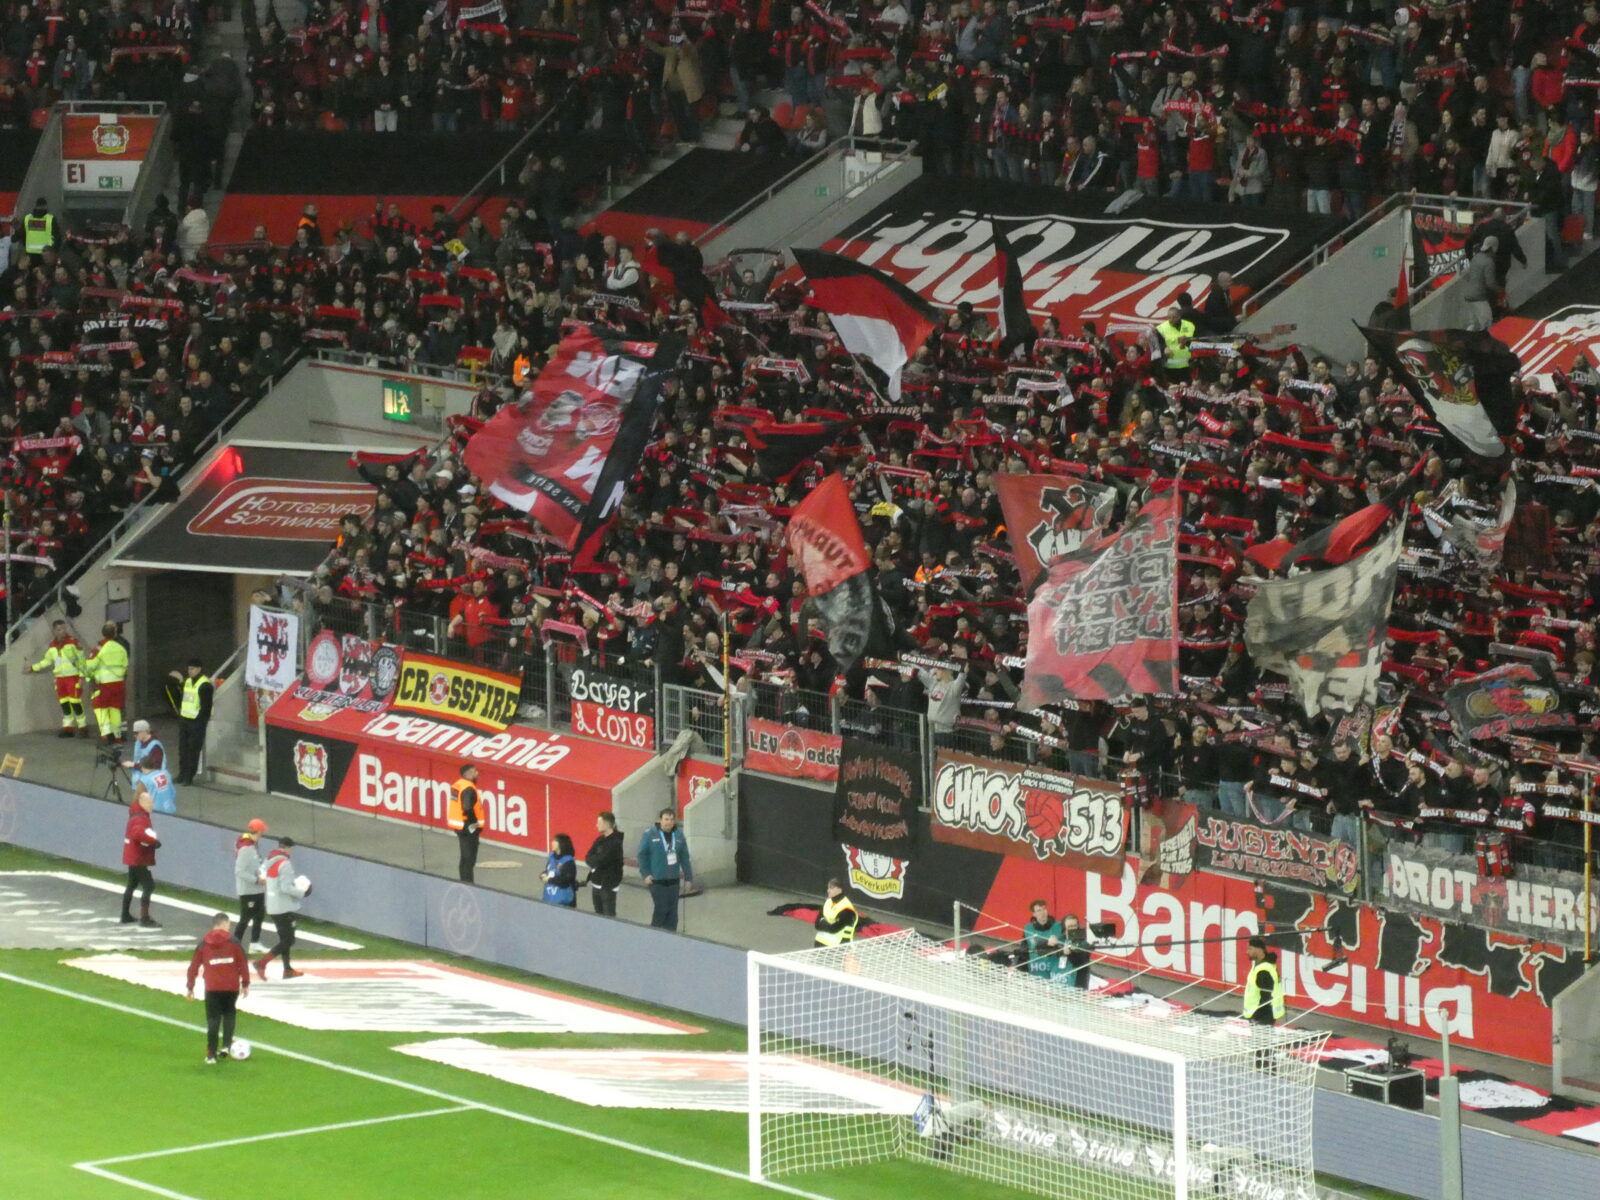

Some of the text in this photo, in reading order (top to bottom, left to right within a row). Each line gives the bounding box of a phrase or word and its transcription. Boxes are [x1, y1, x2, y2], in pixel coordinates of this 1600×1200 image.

[67, 164, 85, 184] E1
[224, 511, 341, 529] SOFTWARE
[571, 668, 648, 714] Bayer
[749, 729, 779, 754] LEV
[359, 753, 528, 837] Barmnia
[933, 763, 1026, 842] CHAOS
[1067, 788, 1124, 857] 513
[1197, 816, 1332, 869] JUGEND
[854, 875, 898, 894] Leverkusen
[1384, 853, 1598, 934] BROT HERS
[1012, 1123, 1057, 1148] trive
[1087, 1142, 1136, 1168] trive
[1166, 1156, 1213, 1184] tive
